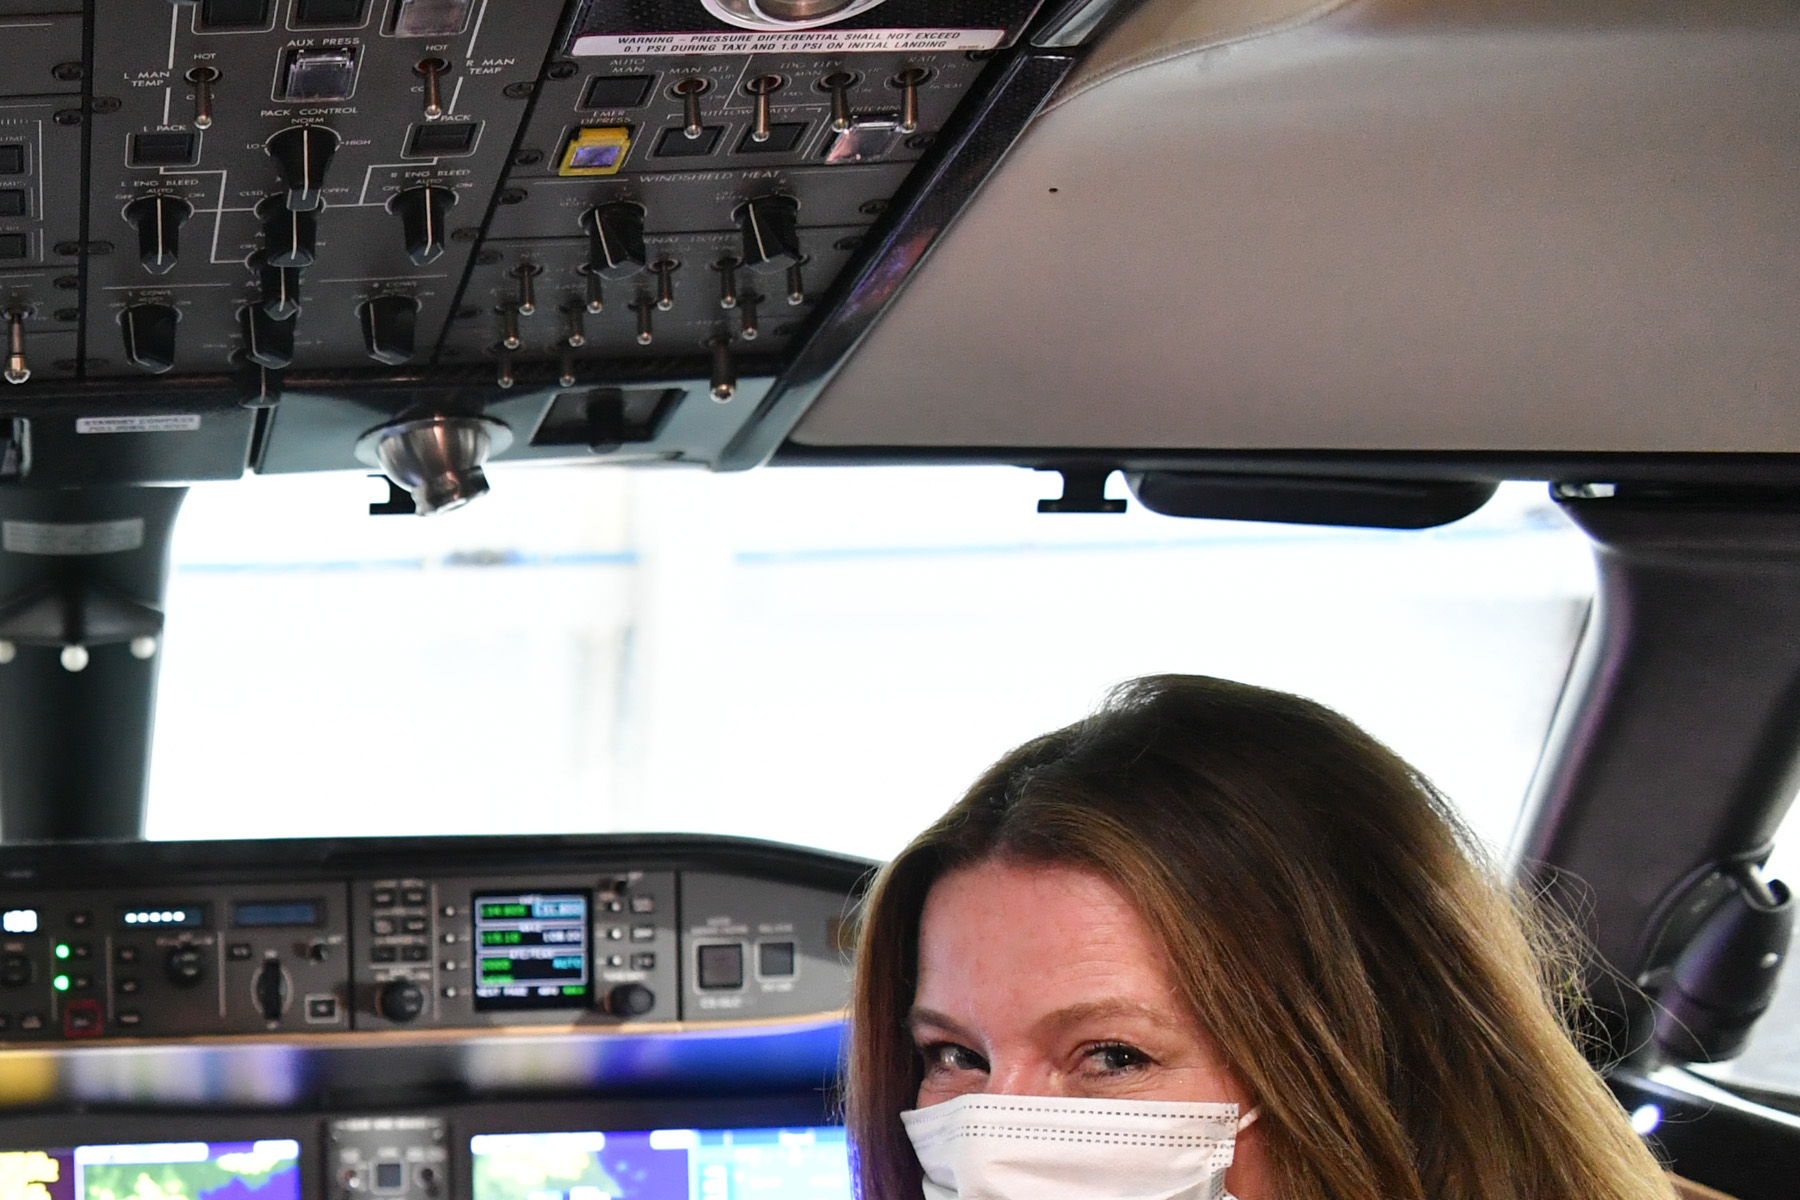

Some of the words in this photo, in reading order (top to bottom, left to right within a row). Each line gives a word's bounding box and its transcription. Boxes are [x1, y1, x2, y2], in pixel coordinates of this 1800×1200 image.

[322, 37, 360, 45] PRESS
[618, 36, 674, 44] WARNING
[690, 35, 752, 44] PRESSURE
[757, 33, 839, 43] DIFFERENTIAL
[844, 33, 882, 41] SHALL
[887, 32, 913, 40] NOT
[915, 31, 961, 39] EXCEED
[623, 45, 642, 53] 0.1
[670, 44, 717, 52] DURING
[781, 42, 799, 50] 1.0
[801, 42, 823, 50] PSI
[847, 41, 890, 49] INITIAL
[894, 40, 947, 49] LANDING
[482, 58, 515, 66] MAN
[469, 67, 504, 75] TEMP
[260, 109, 291, 117] PACK
[299, 107, 358, 115] CONTROL
[850, 105, 901, 113] DITCHIN
[639, 172, 733, 183] WINDSHIELD
[741, 170, 781, 180] HEAT
